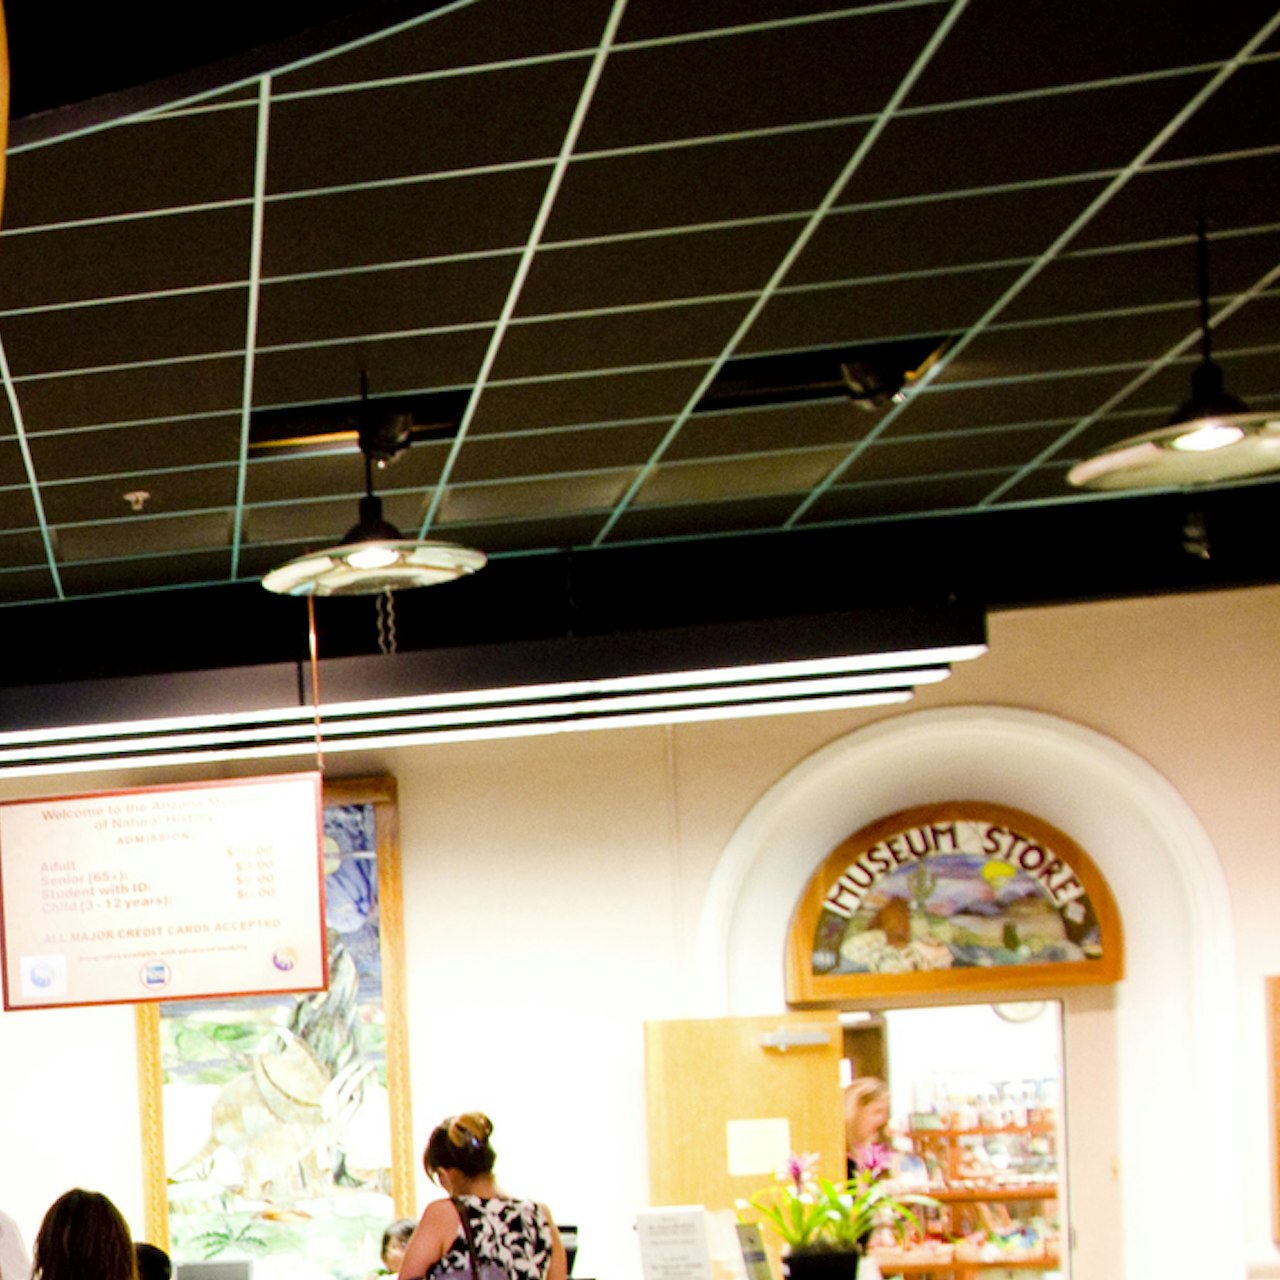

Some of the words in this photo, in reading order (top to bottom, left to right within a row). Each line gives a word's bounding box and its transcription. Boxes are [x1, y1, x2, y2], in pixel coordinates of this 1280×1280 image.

[40, 806, 104, 822] Welcome
[107, 804, 121, 816] to
[126, 802, 146, 814] the
[93, 819, 108, 831] of
[111, 815, 161, 830] Natural
[826, 825, 958, 916] MUSEUM
[981, 825, 1080, 907] STORE
[40, 874, 85, 887] Senior
[40, 886, 96, 900] Student
[98, 883, 129, 896] with
[41, 900, 77, 913] Child
[105, 898, 121, 910] 12
[45, 932, 66, 945] ALL
[70, 929, 115, 942] MAJOR
[117, 926, 164, 939] CREDIT
[167, 923, 210, 936] CARDS
[213, 918, 282, 931] ACCEPTED
